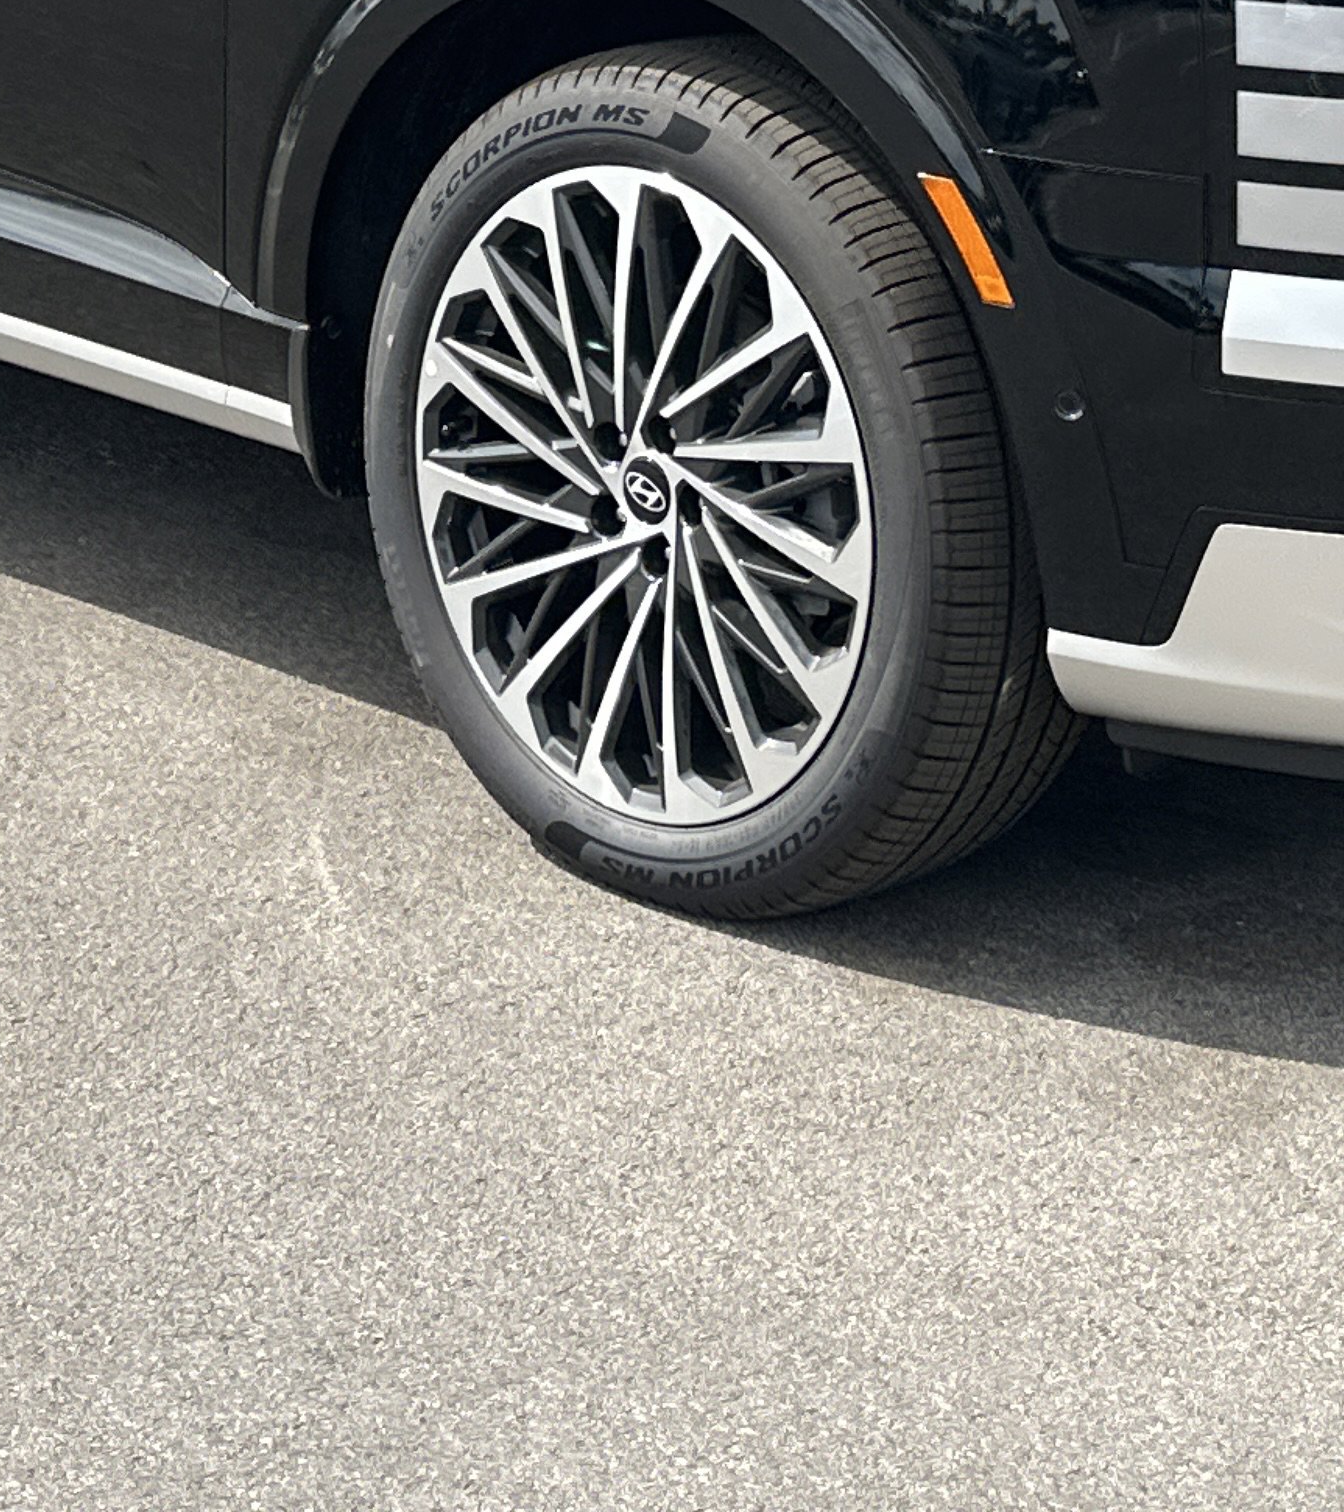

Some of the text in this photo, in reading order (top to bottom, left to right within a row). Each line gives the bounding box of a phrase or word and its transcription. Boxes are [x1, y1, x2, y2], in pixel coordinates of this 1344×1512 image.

[431, 103, 652, 222] SCORPION MS
[602, 854, 655, 884] MS
[668, 794, 843, 888] SCORPION
